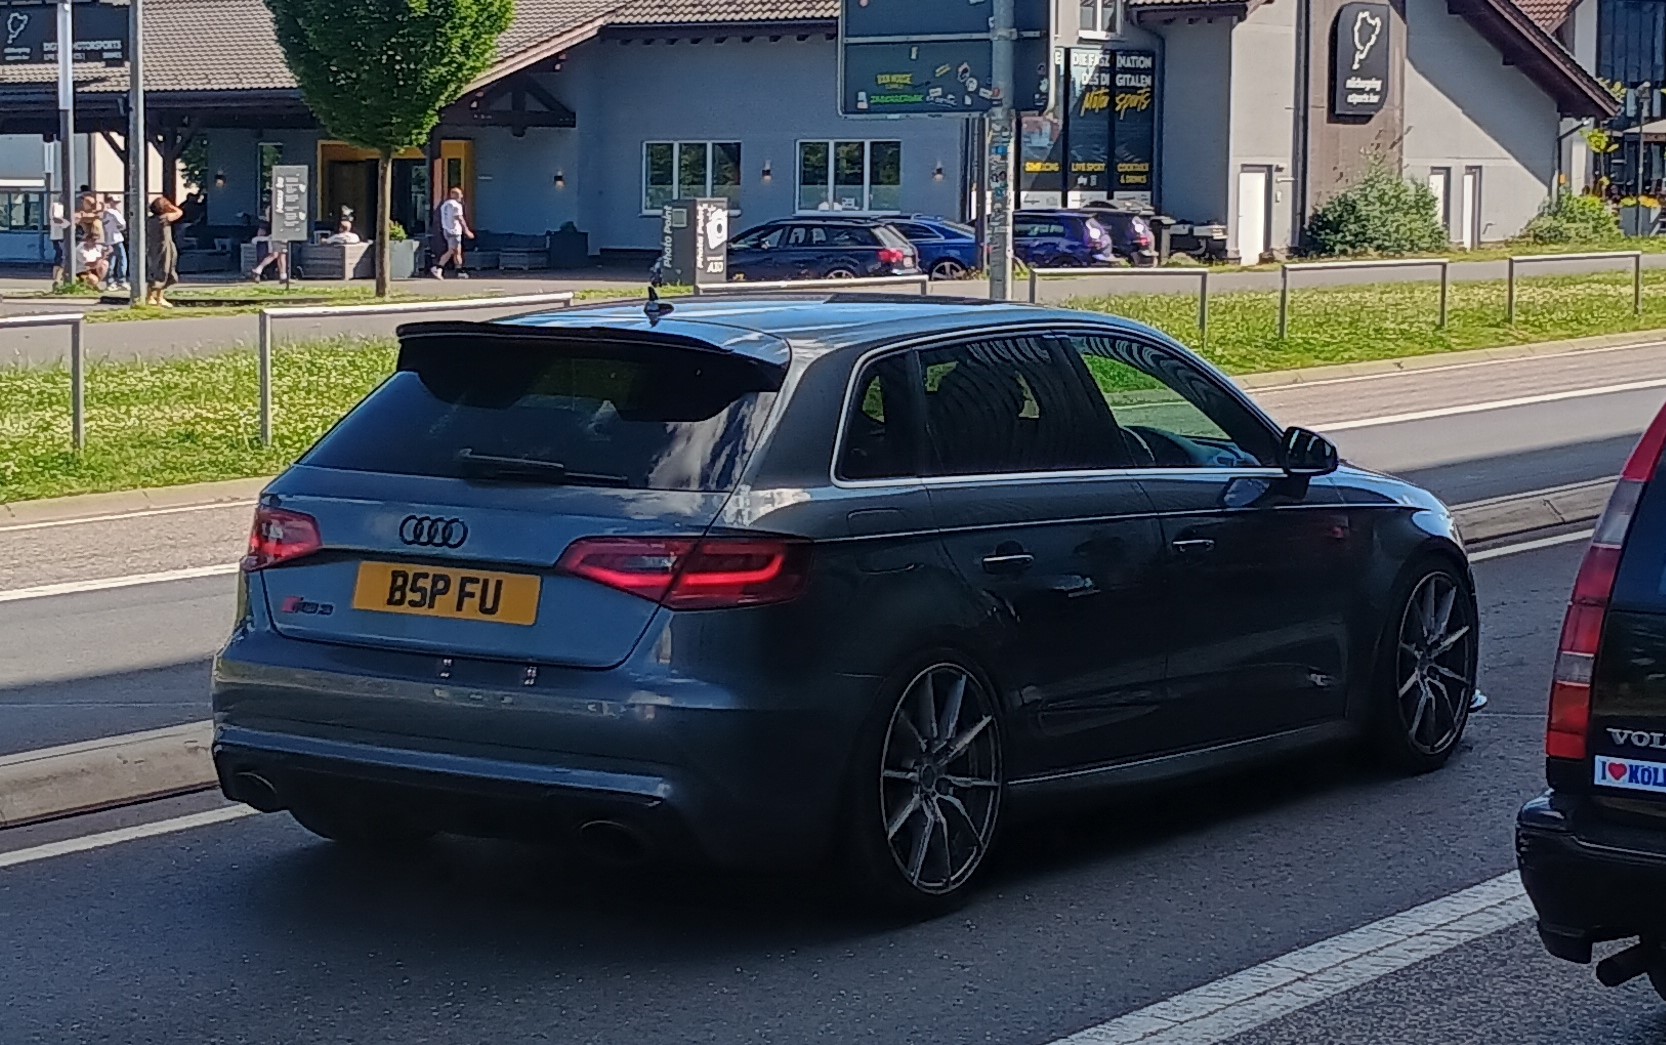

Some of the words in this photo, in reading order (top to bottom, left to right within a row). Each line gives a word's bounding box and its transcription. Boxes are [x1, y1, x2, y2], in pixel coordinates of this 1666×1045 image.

[456, 576, 503, 615] FU
[1606, 727, 1666, 749] VOL
[1628, 764, 1666, 787] KÖL
